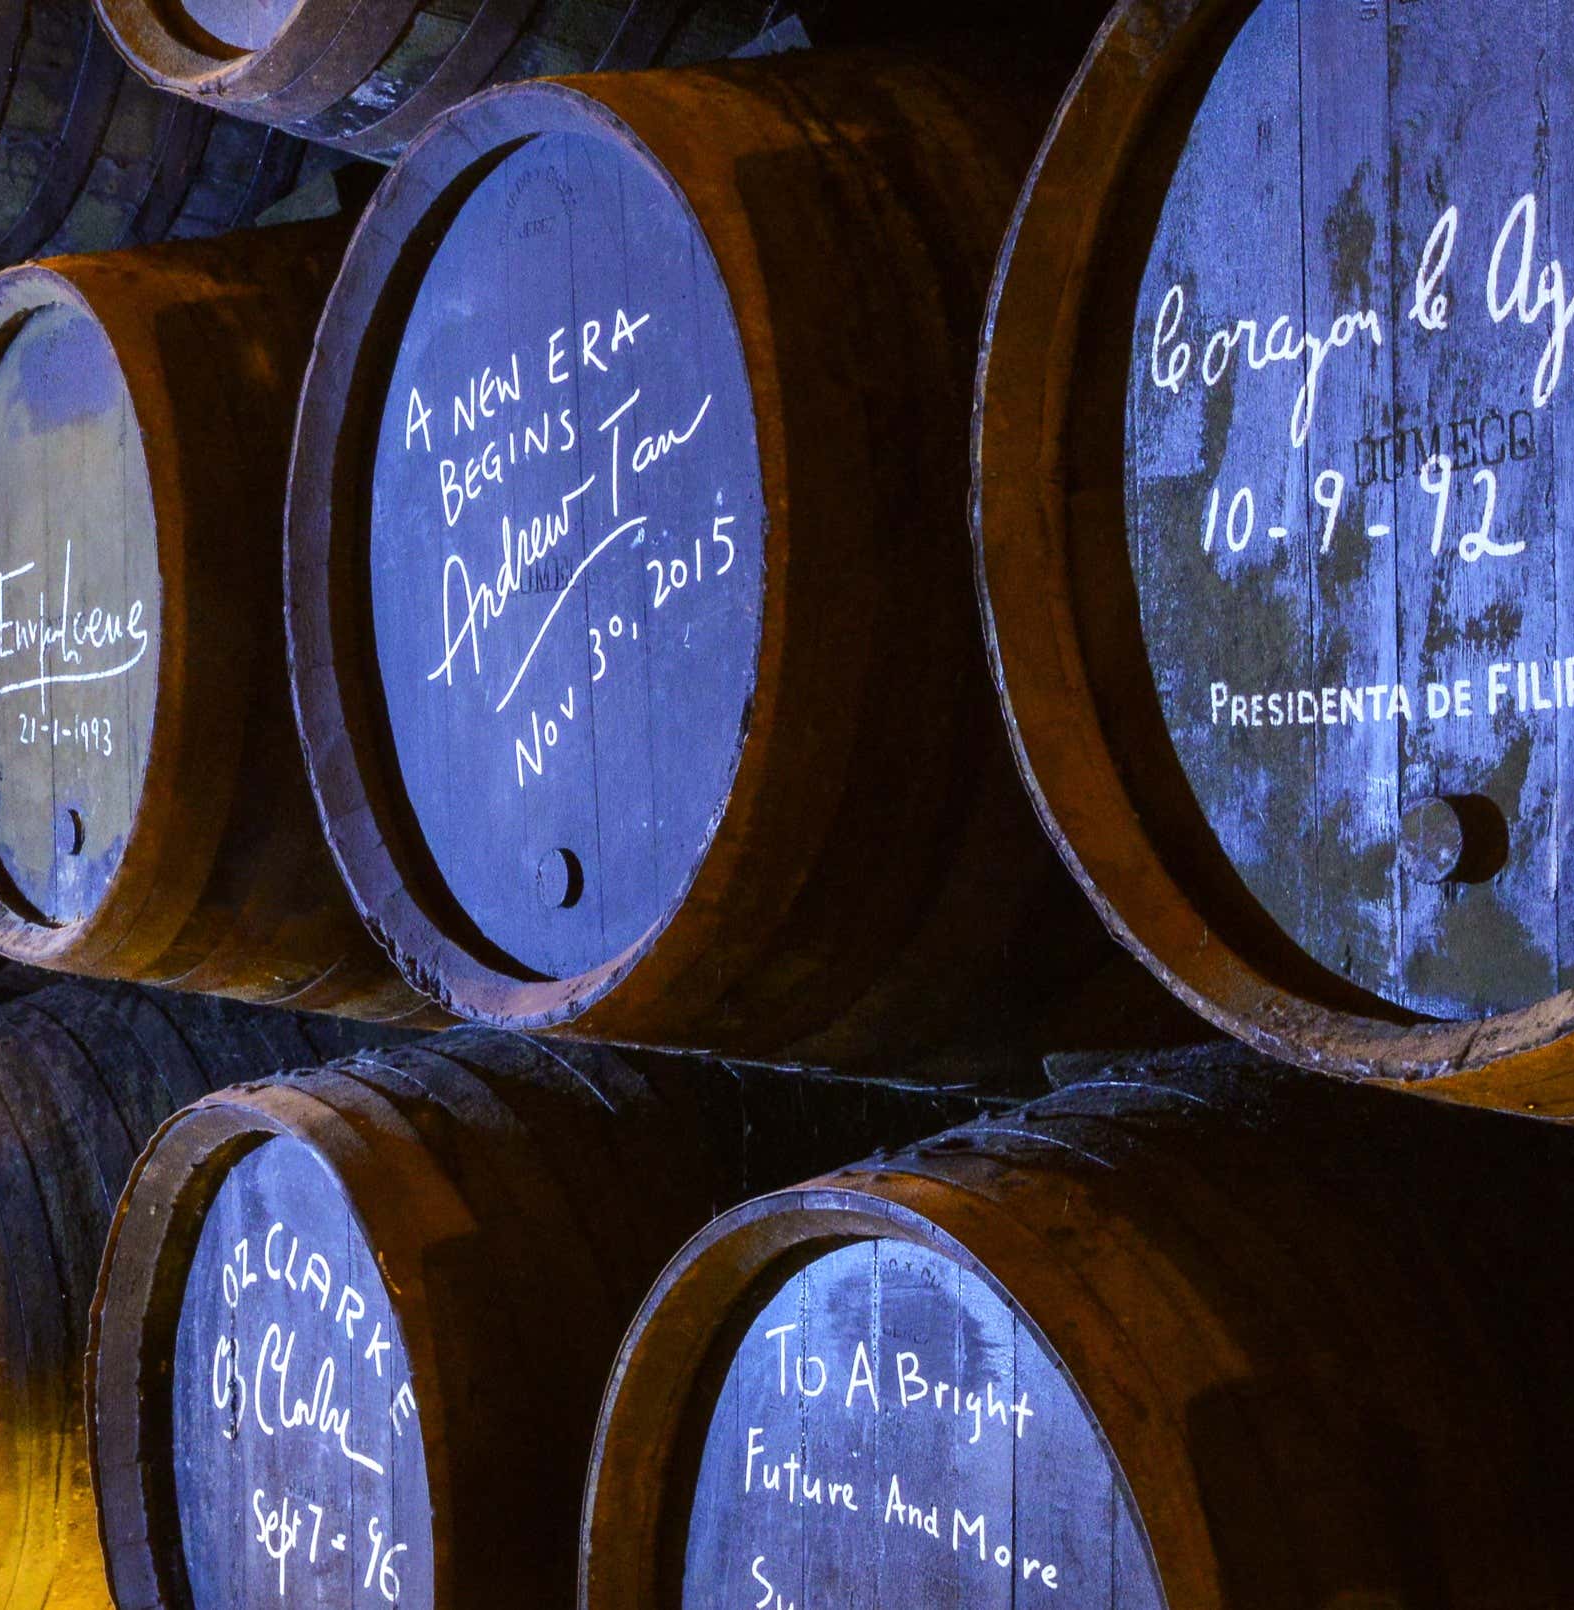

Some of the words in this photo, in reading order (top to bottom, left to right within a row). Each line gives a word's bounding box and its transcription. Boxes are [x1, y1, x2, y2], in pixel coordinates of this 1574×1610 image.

[405, 386, 433, 452] A
[453, 352, 521, 436] NEW
[547, 308, 651, 384] ERA
[439, 408, 576, 528] BEGINS
[426, 473, 596, 688] Andrew
[515, 686, 574, 788] Nov
[588, 614, 639, 682] 30,
[646, 515, 736, 609] 2015
[1426, 679, 1474, 720] DE
[222, 1237, 258, 1309] OZ
[263, 1220, 418, 1437] CLARKE
[844, 1340, 880, 1413] A
[895, 1350, 1035, 1445] Bright
[363, 1516, 409, 1603] 96
[743, 1426, 859, 1512] Future
[883, 1473, 942, 1539] And
[951, 1508, 1059, 1591] More
